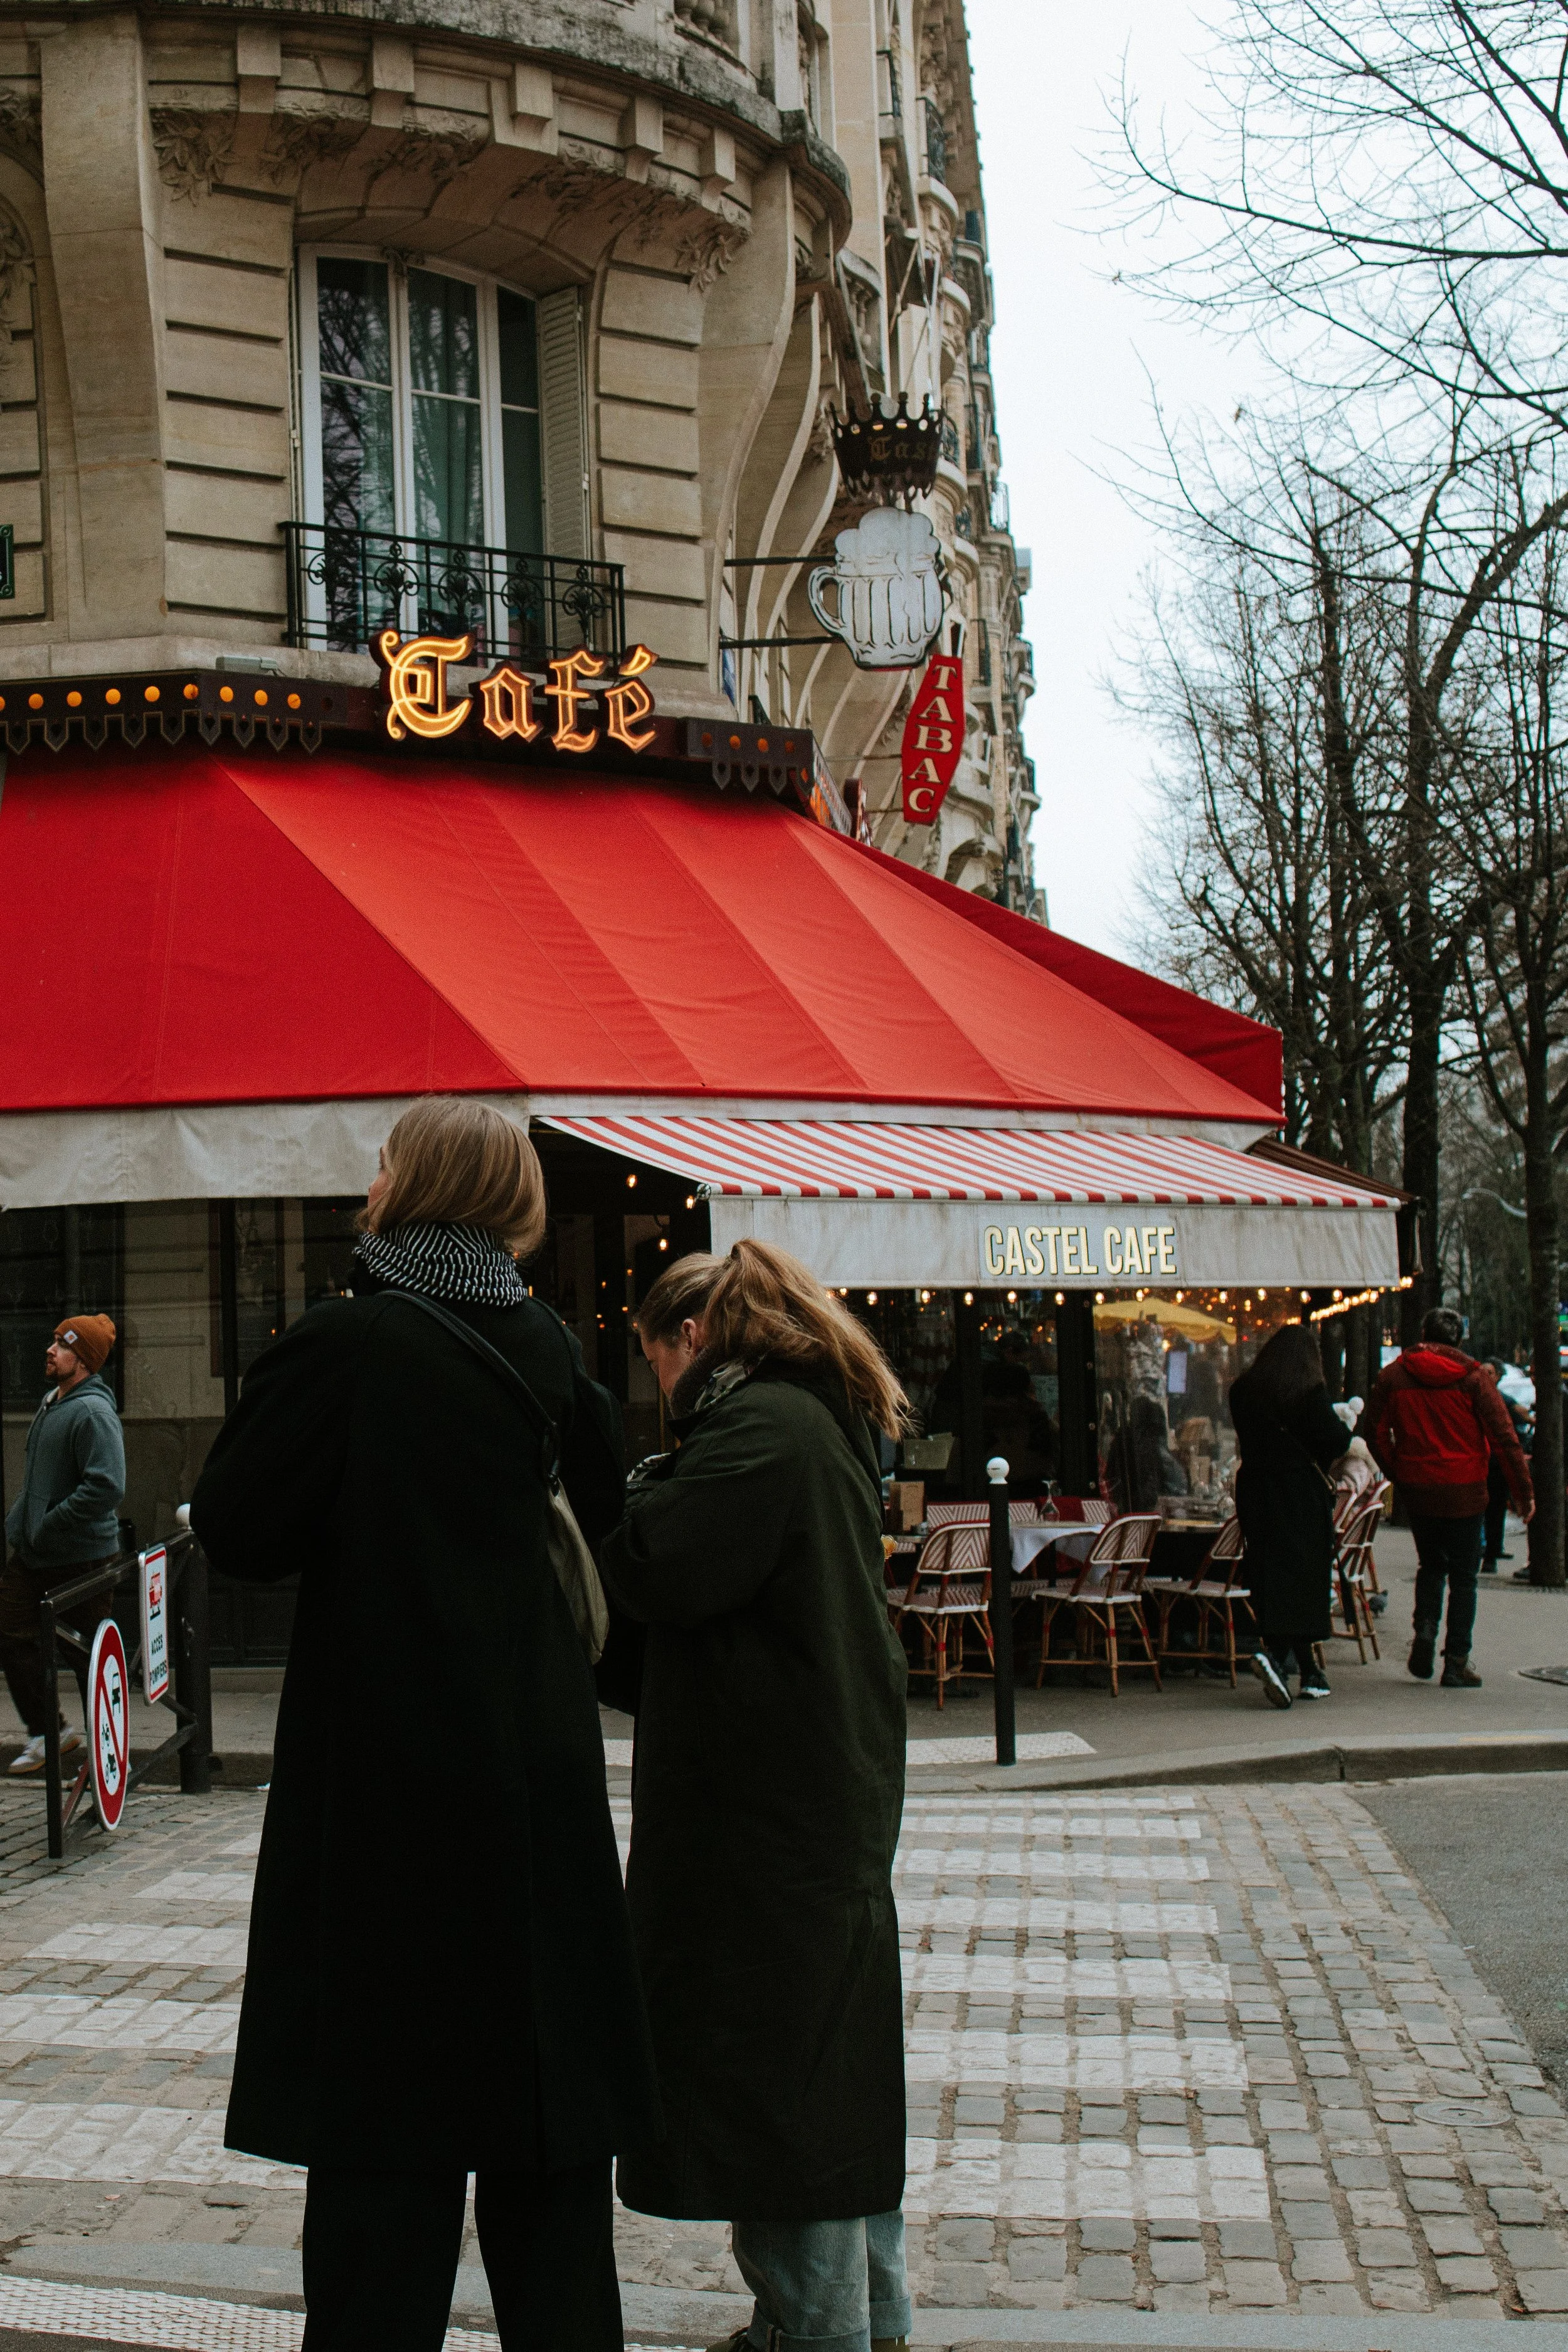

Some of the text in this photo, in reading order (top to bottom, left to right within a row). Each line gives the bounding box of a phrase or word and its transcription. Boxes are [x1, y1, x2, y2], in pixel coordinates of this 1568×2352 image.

[376, 629, 657, 752] Café
[907, 665, 958, 813] TABAC
[984, 1226, 1177, 1275] CASTEL CAFE
